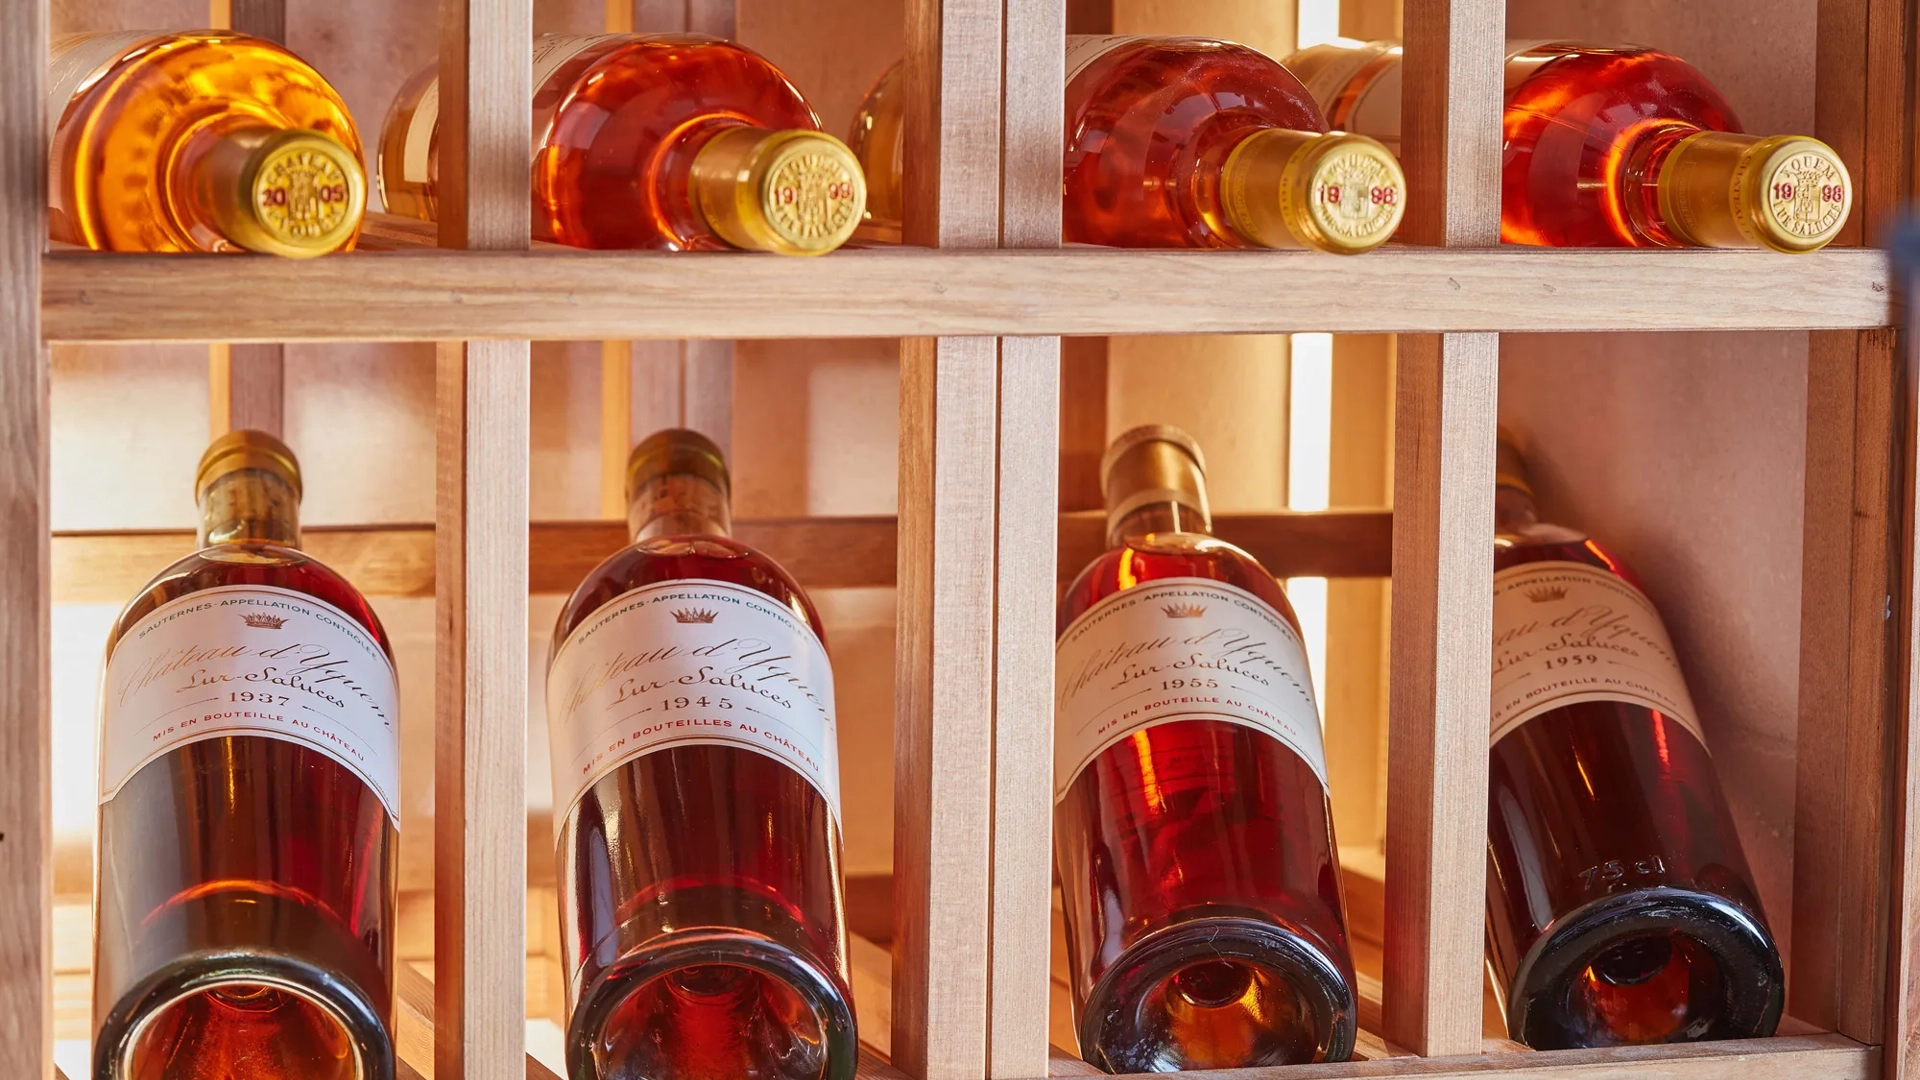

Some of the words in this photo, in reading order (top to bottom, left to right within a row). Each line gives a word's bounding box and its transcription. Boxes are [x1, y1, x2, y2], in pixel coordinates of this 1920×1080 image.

[1780, 156, 1837, 181] YQUEM
[262, 188, 287, 206] 20
[321, 185, 345, 203] 05
[775, 186, 796, 205] 19
[828, 182, 853, 200] 99
[1774, 183, 1793, 202] 19
[1822, 184, 1842, 202] 98
[1493, 633, 1640, 673] Lur-Saluces
[1544, 654, 1598, 670] 1959
[1110, 653, 1269, 691] Lur-Saluces
[1161, 678, 1219, 692] 1955
[176, 667, 345, 708] Lur-Saluces
[228, 691, 290, 706] 1937
[605, 665, 792, 711] Lur-Saluces
[1505, 698, 1522, 711] EN
[1525, 677, 1598, 698] BOUTEILLE
[1604, 678, 1622, 686] AU
[659, 696, 733, 711] 1945
[1097, 719, 1118, 735] MIS
[1123, 708, 1139, 719] EN
[1144, 696, 1219, 711] BOUTEILLE
[1226, 699, 1242, 708] AU
[152, 726, 174, 742] MIS
[180, 717, 197, 728] EN
[204, 711, 284, 722] BOUTEILLE
[292, 718, 309, 729] AU
[582, 752, 604, 775] MIS
[609, 737, 626, 753] EN
[632, 719, 732, 740] BOUTEILLES
[739, 723, 758, 733] AU
